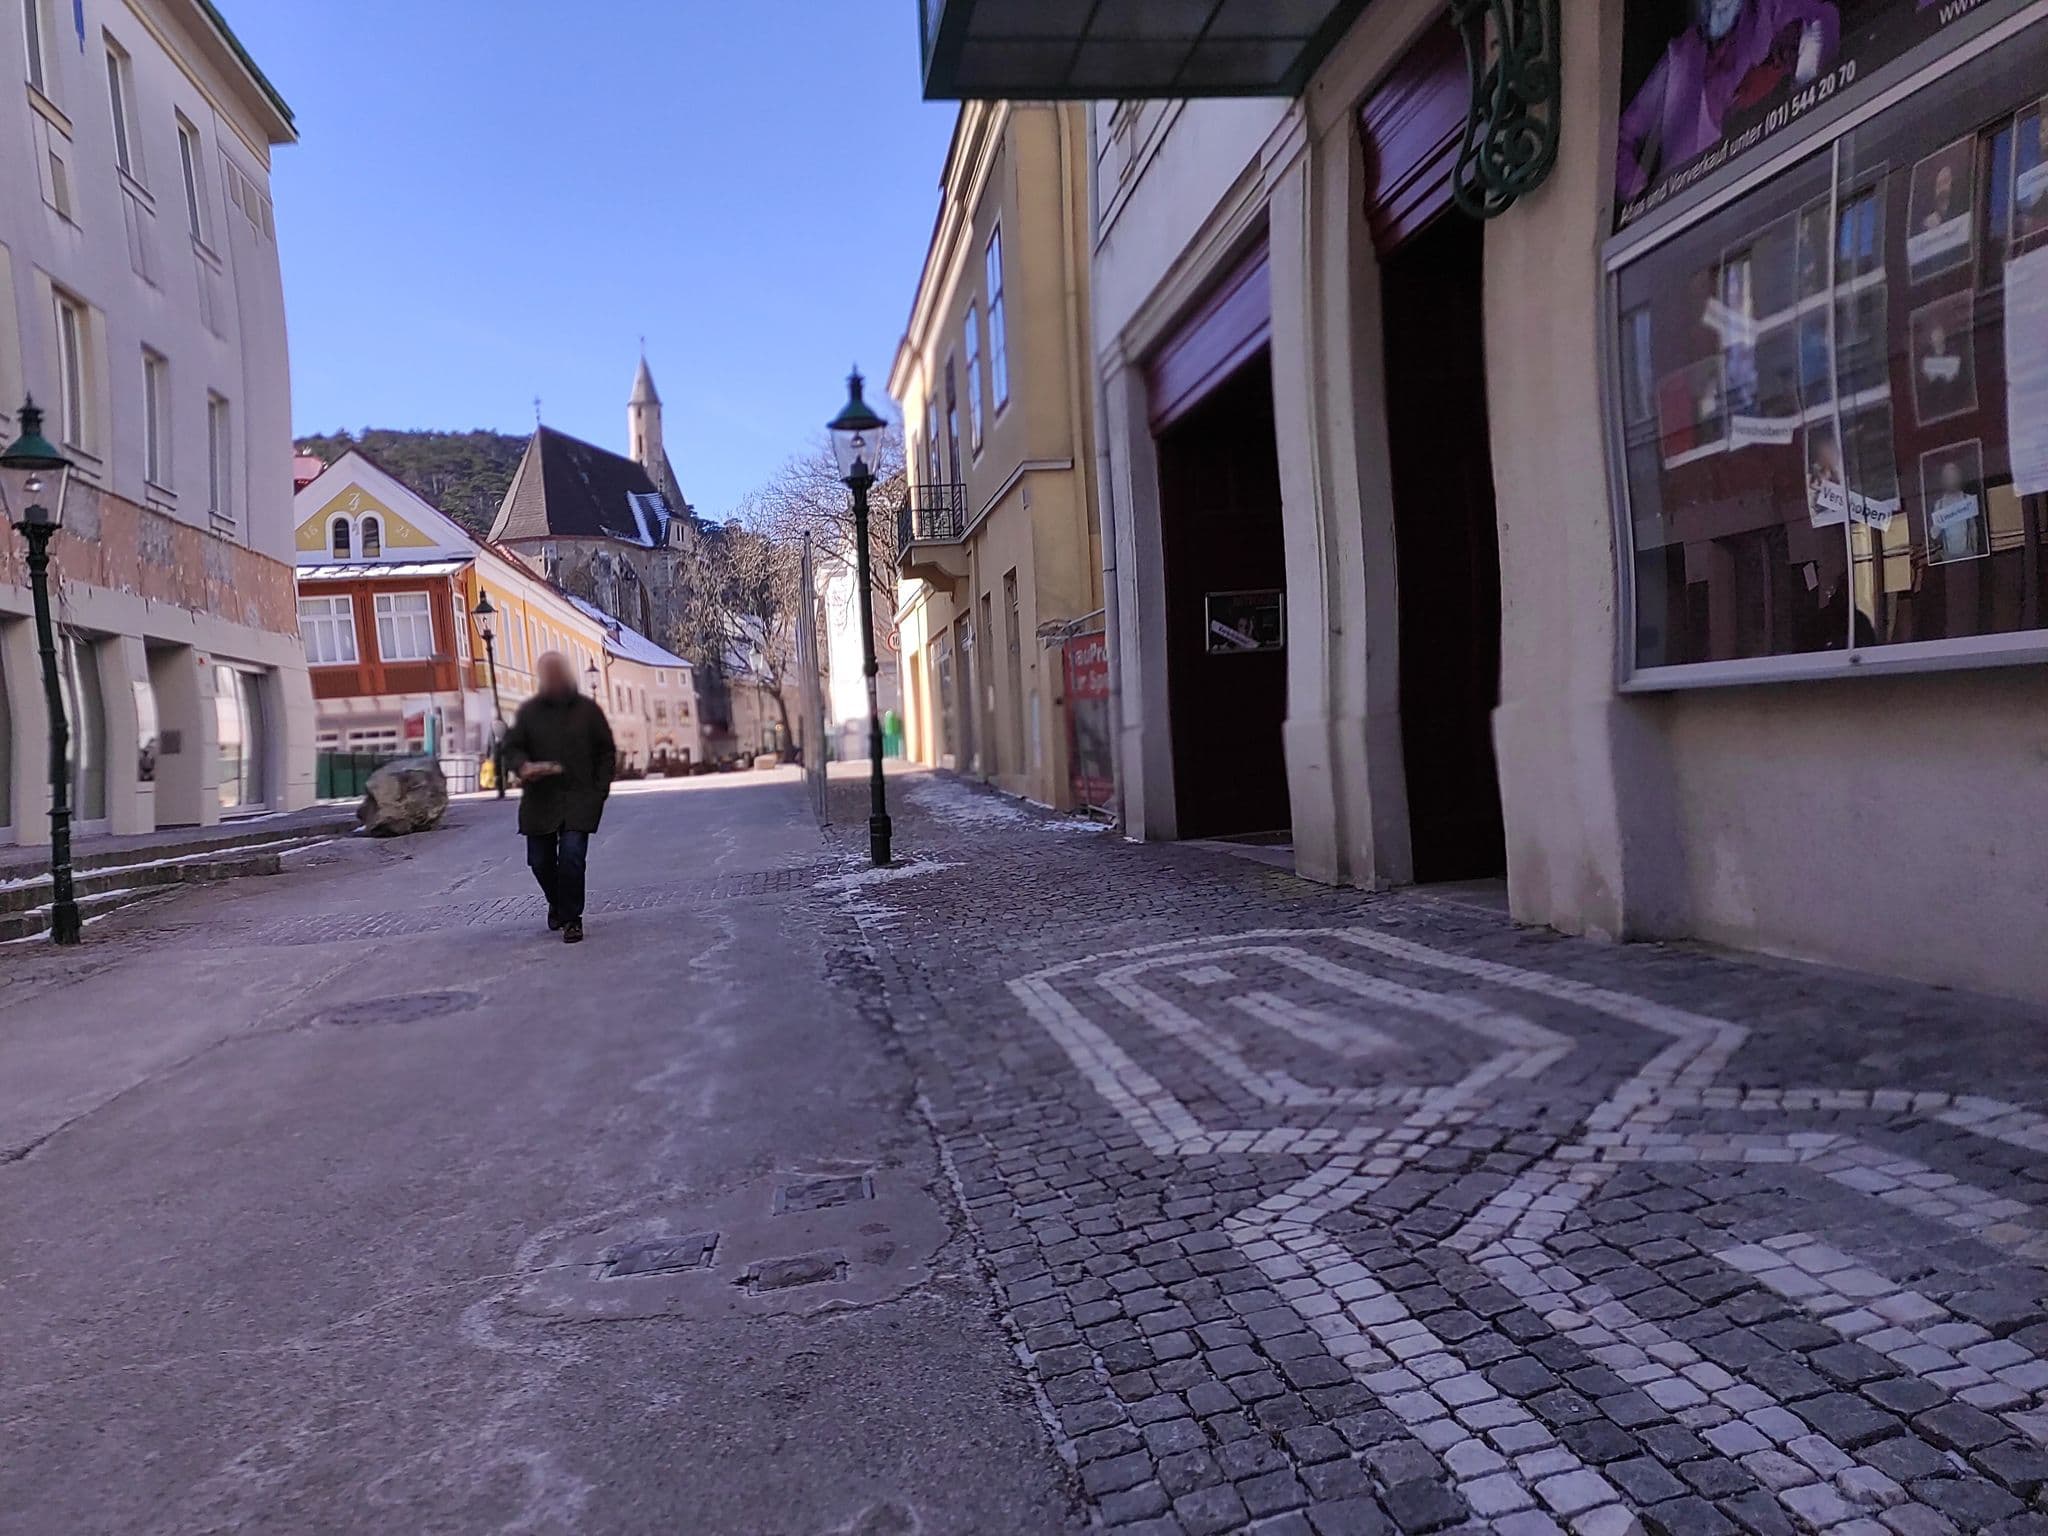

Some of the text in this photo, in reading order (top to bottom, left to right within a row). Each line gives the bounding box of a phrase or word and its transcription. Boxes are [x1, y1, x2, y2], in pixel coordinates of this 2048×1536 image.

[1729, 122, 1763, 156] unter
[1764, 101, 1789, 137] (01)
[1791, 84, 1816, 117] 544
[1818, 73, 1837, 101] 20
[1838, 59, 1857, 88] 70
